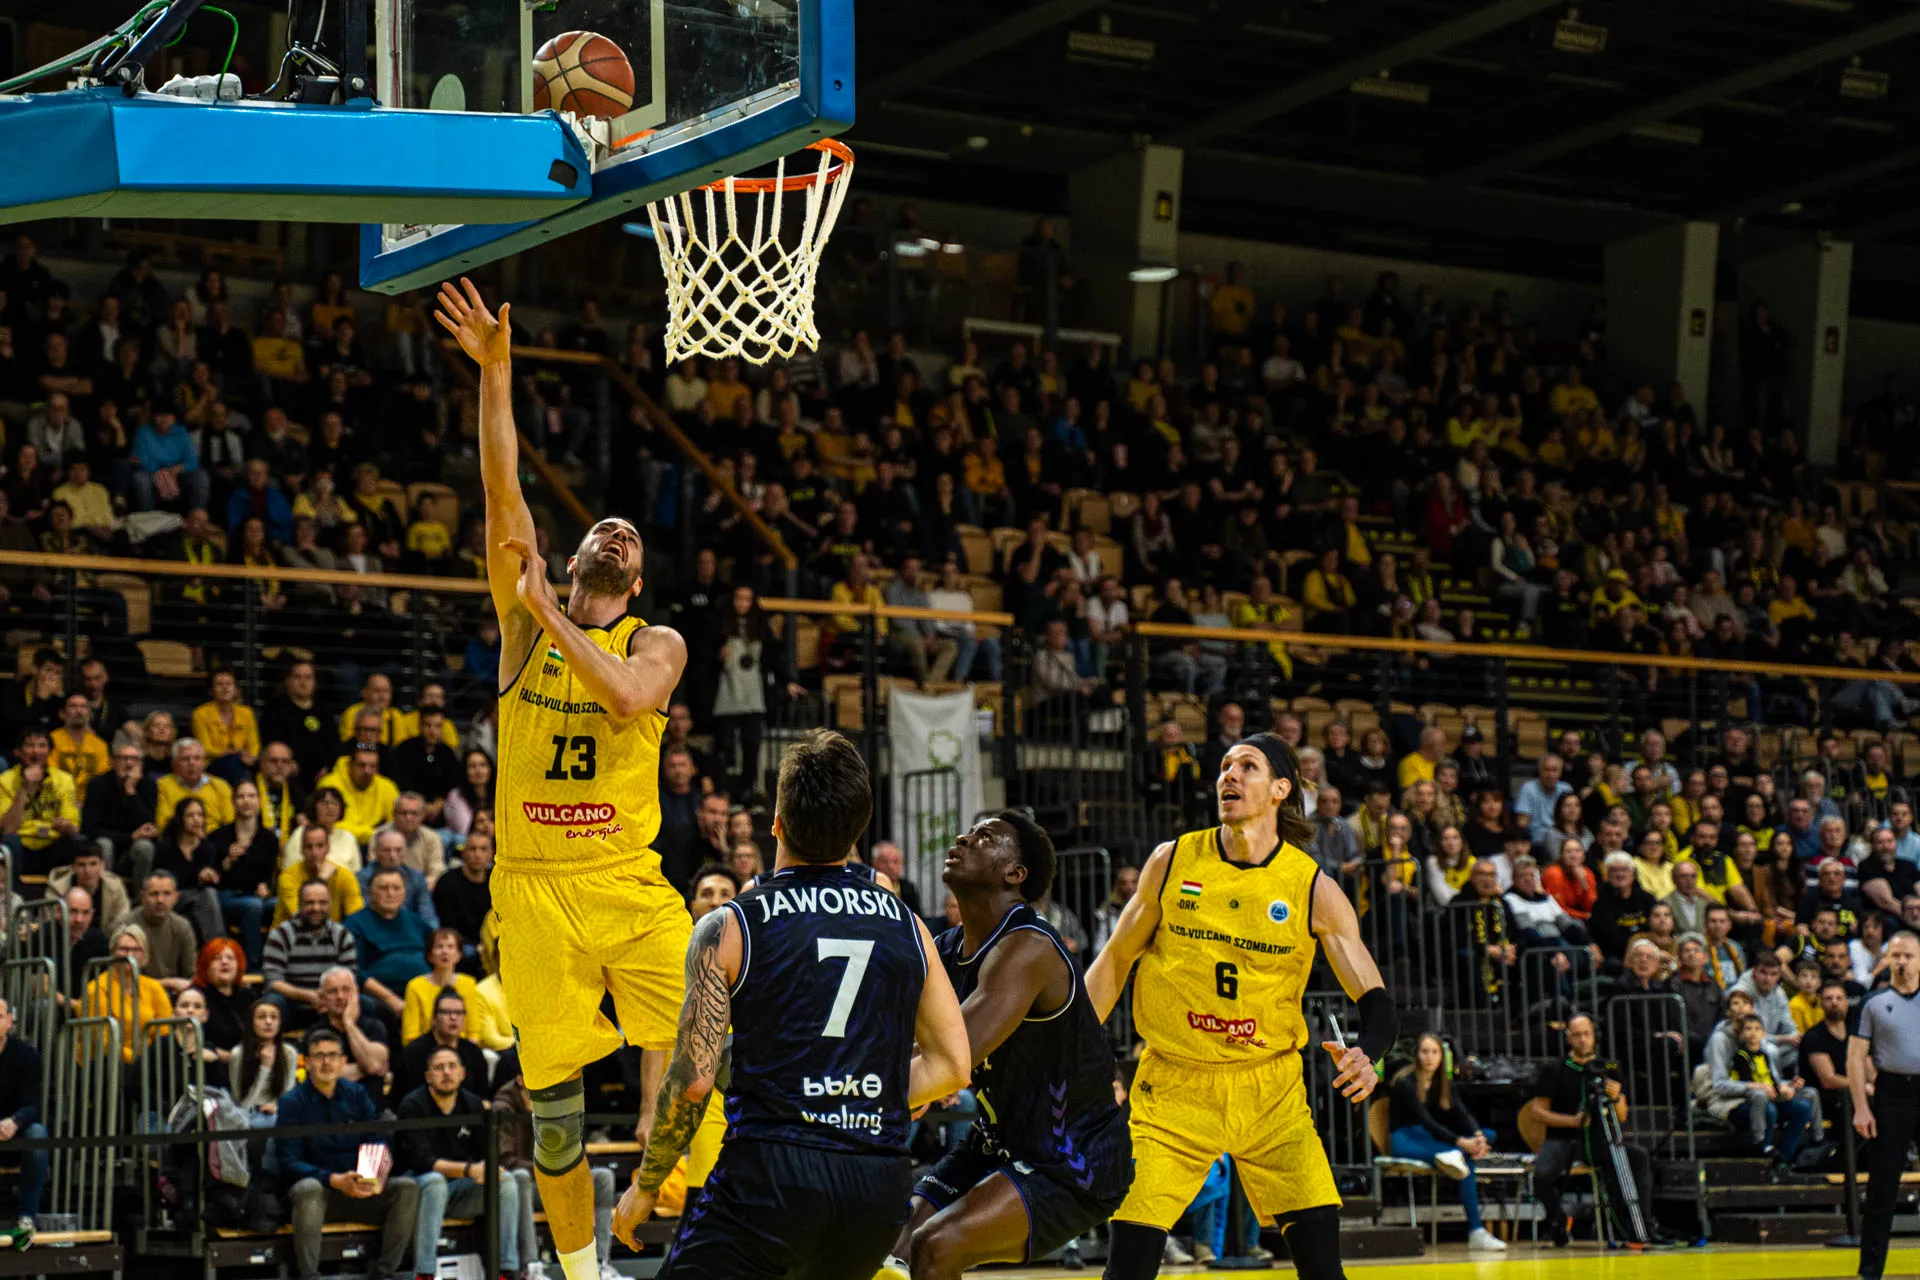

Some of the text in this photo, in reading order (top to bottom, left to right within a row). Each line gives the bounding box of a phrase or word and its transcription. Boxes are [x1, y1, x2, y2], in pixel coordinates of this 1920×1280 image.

[545, 734, 596, 781] 13
[525, 804, 612, 823] VULCANO
[565, 823, 623, 840] energia
[755, 887, 902, 924] JAWORSKI
[816, 937, 875, 1038] 7
[1215, 962, 1238, 1000] 6
